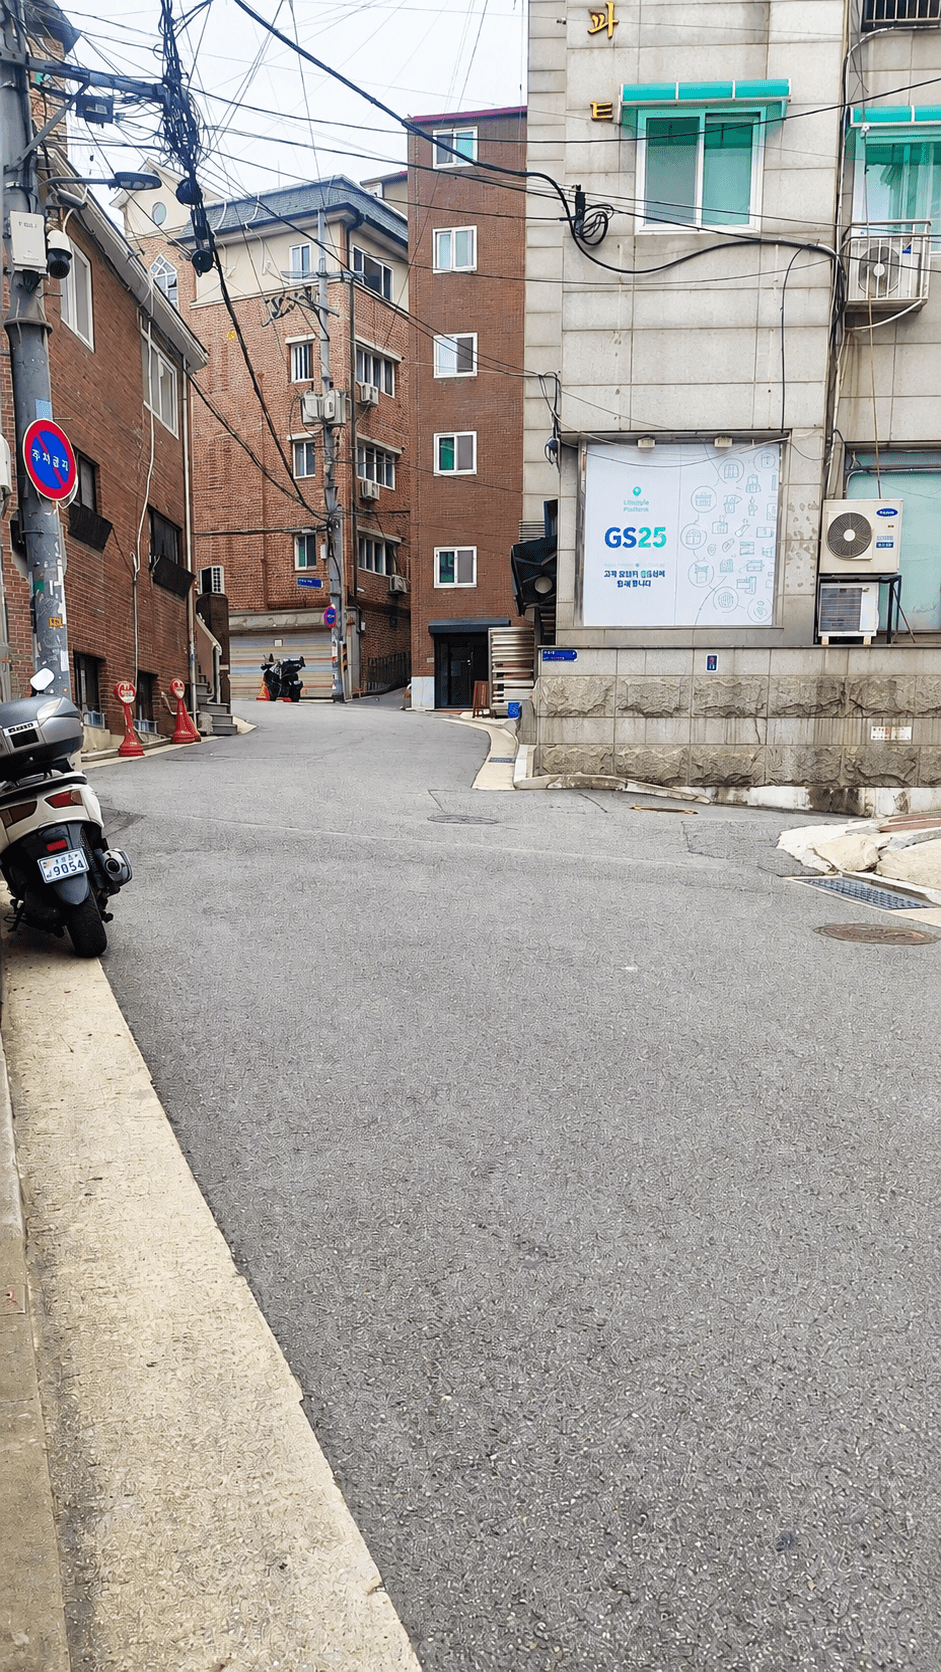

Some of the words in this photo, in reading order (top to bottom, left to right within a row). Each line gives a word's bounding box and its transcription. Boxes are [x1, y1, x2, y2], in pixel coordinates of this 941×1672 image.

[32, 448, 68, 471] 주차금지
[604, 527, 667, 548] GS25
[53, 859, 84, 876] 9054
